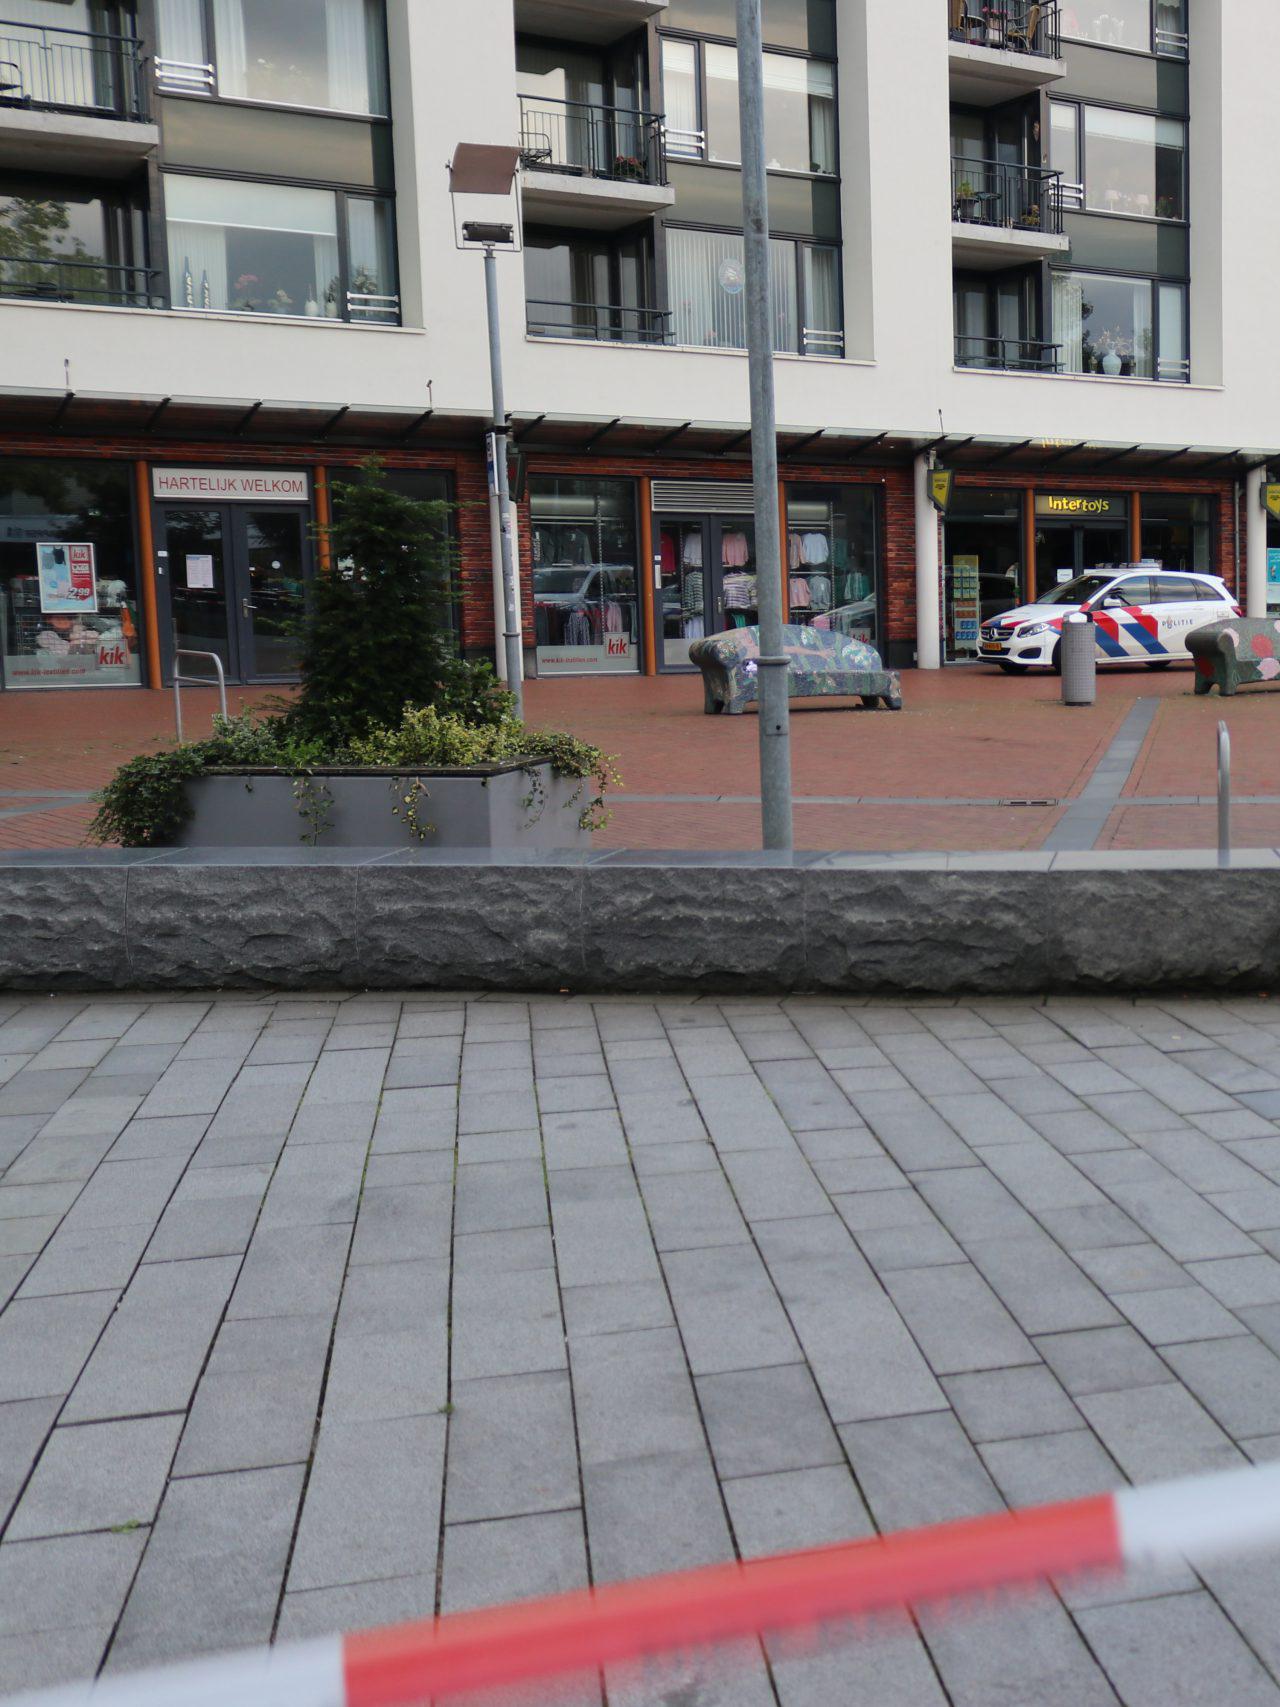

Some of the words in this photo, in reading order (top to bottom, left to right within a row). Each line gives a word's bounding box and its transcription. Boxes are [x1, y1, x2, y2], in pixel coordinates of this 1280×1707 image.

[158, 476, 238, 491] HARTELIJK
[240, 479, 304, 493] WELKOM
[1048, 495, 1110, 514] Intertoys
[1162, 616, 1194, 629] POLITIE
[99, 644, 124, 665] kik
[608, 638, 627, 655] kik
